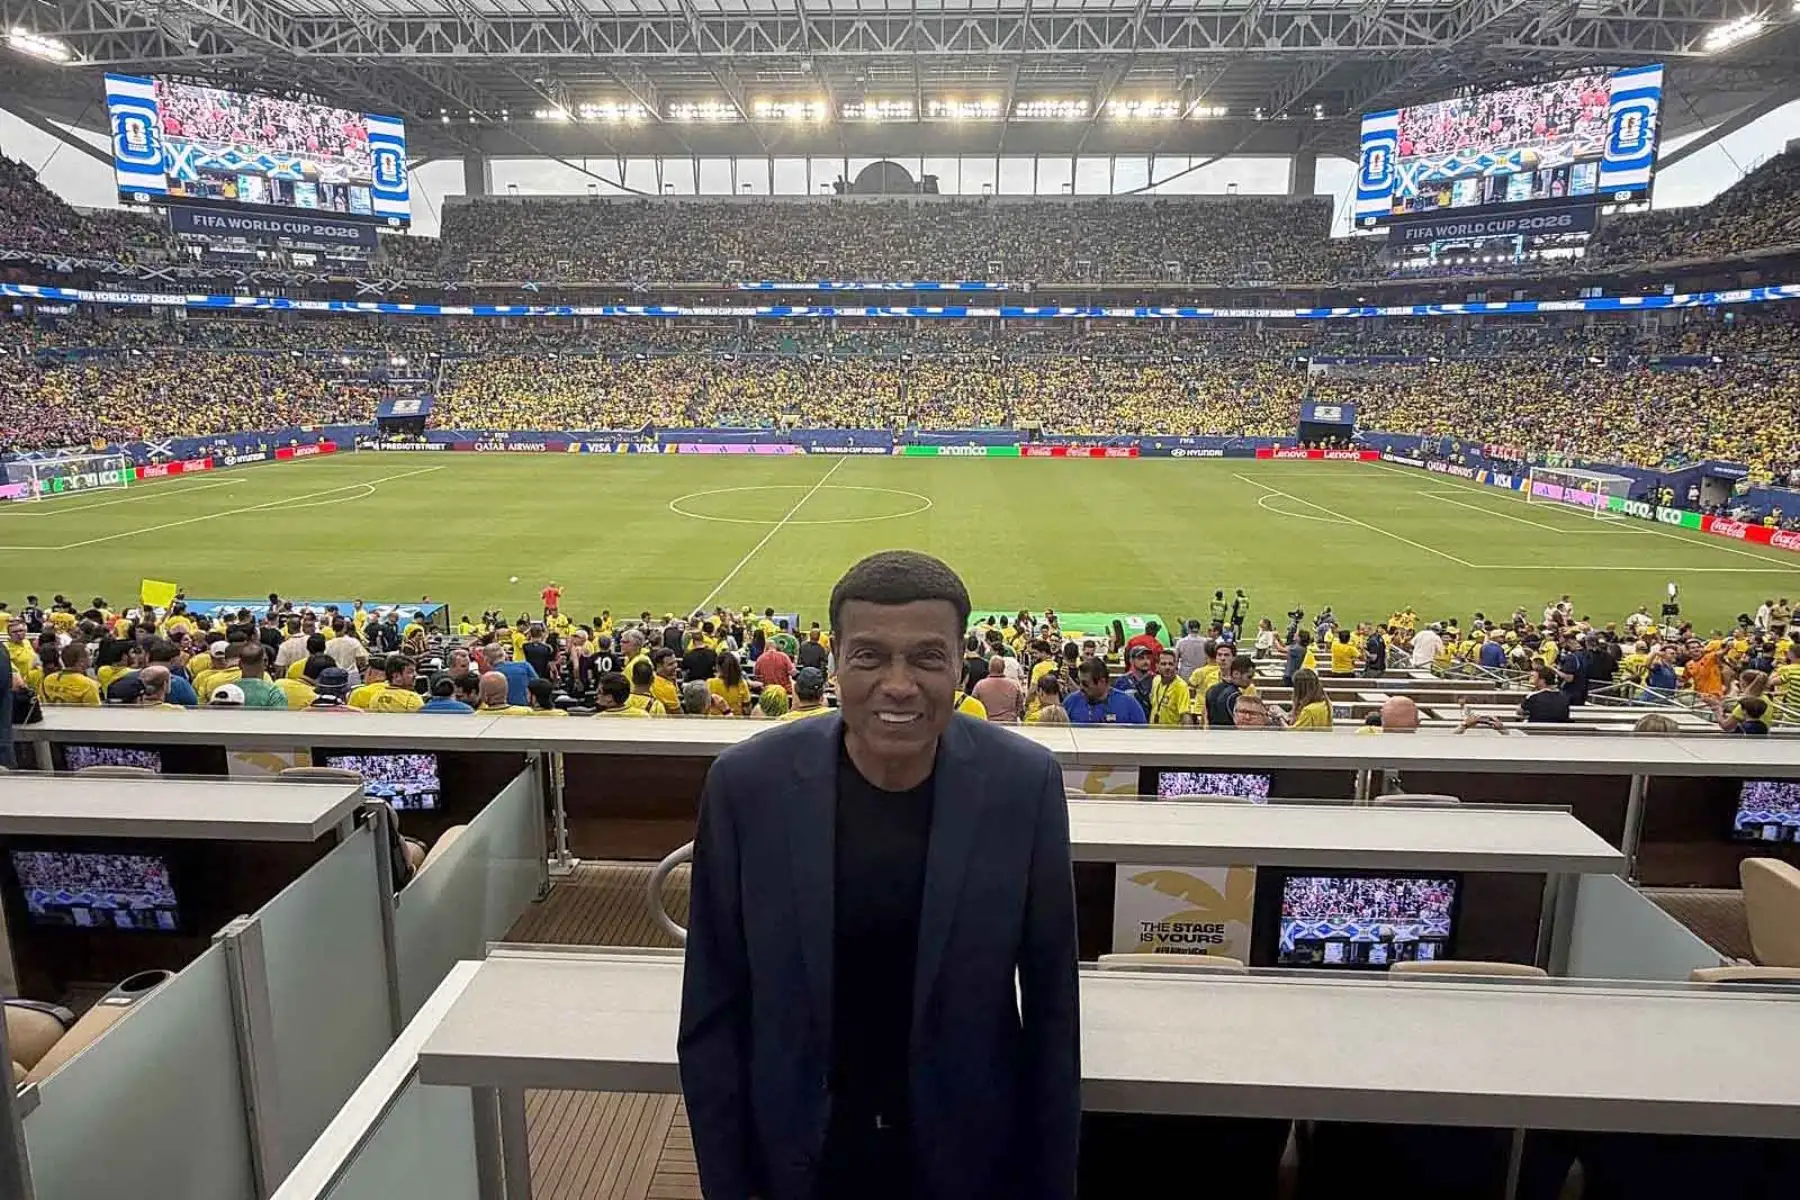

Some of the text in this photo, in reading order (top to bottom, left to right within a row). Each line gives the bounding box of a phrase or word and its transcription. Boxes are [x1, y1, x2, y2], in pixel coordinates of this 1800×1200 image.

[193, 215, 360, 238] FIFA WORLD CUP 2026
[1405, 214, 1573, 239] FIFA WORLD CUP 2026
[474, 442, 546, 451] QATAR AIRWAYS
[587, 443, 612, 452] VISA
[634, 443, 659, 452] VISA
[938, 445, 987, 455] aramco
[1272, 449, 1308, 458] Lenovo
[1323, 450, 1361, 459] Lenovo
[1494, 472, 1512, 488] VISA
[1711, 518, 1746, 539] Coca-Cola
[594, 656, 612, 672] 10
[1140, 922, 1224, 933] THE STAGE
[1140, 933, 1224, 944] IS YOURS
